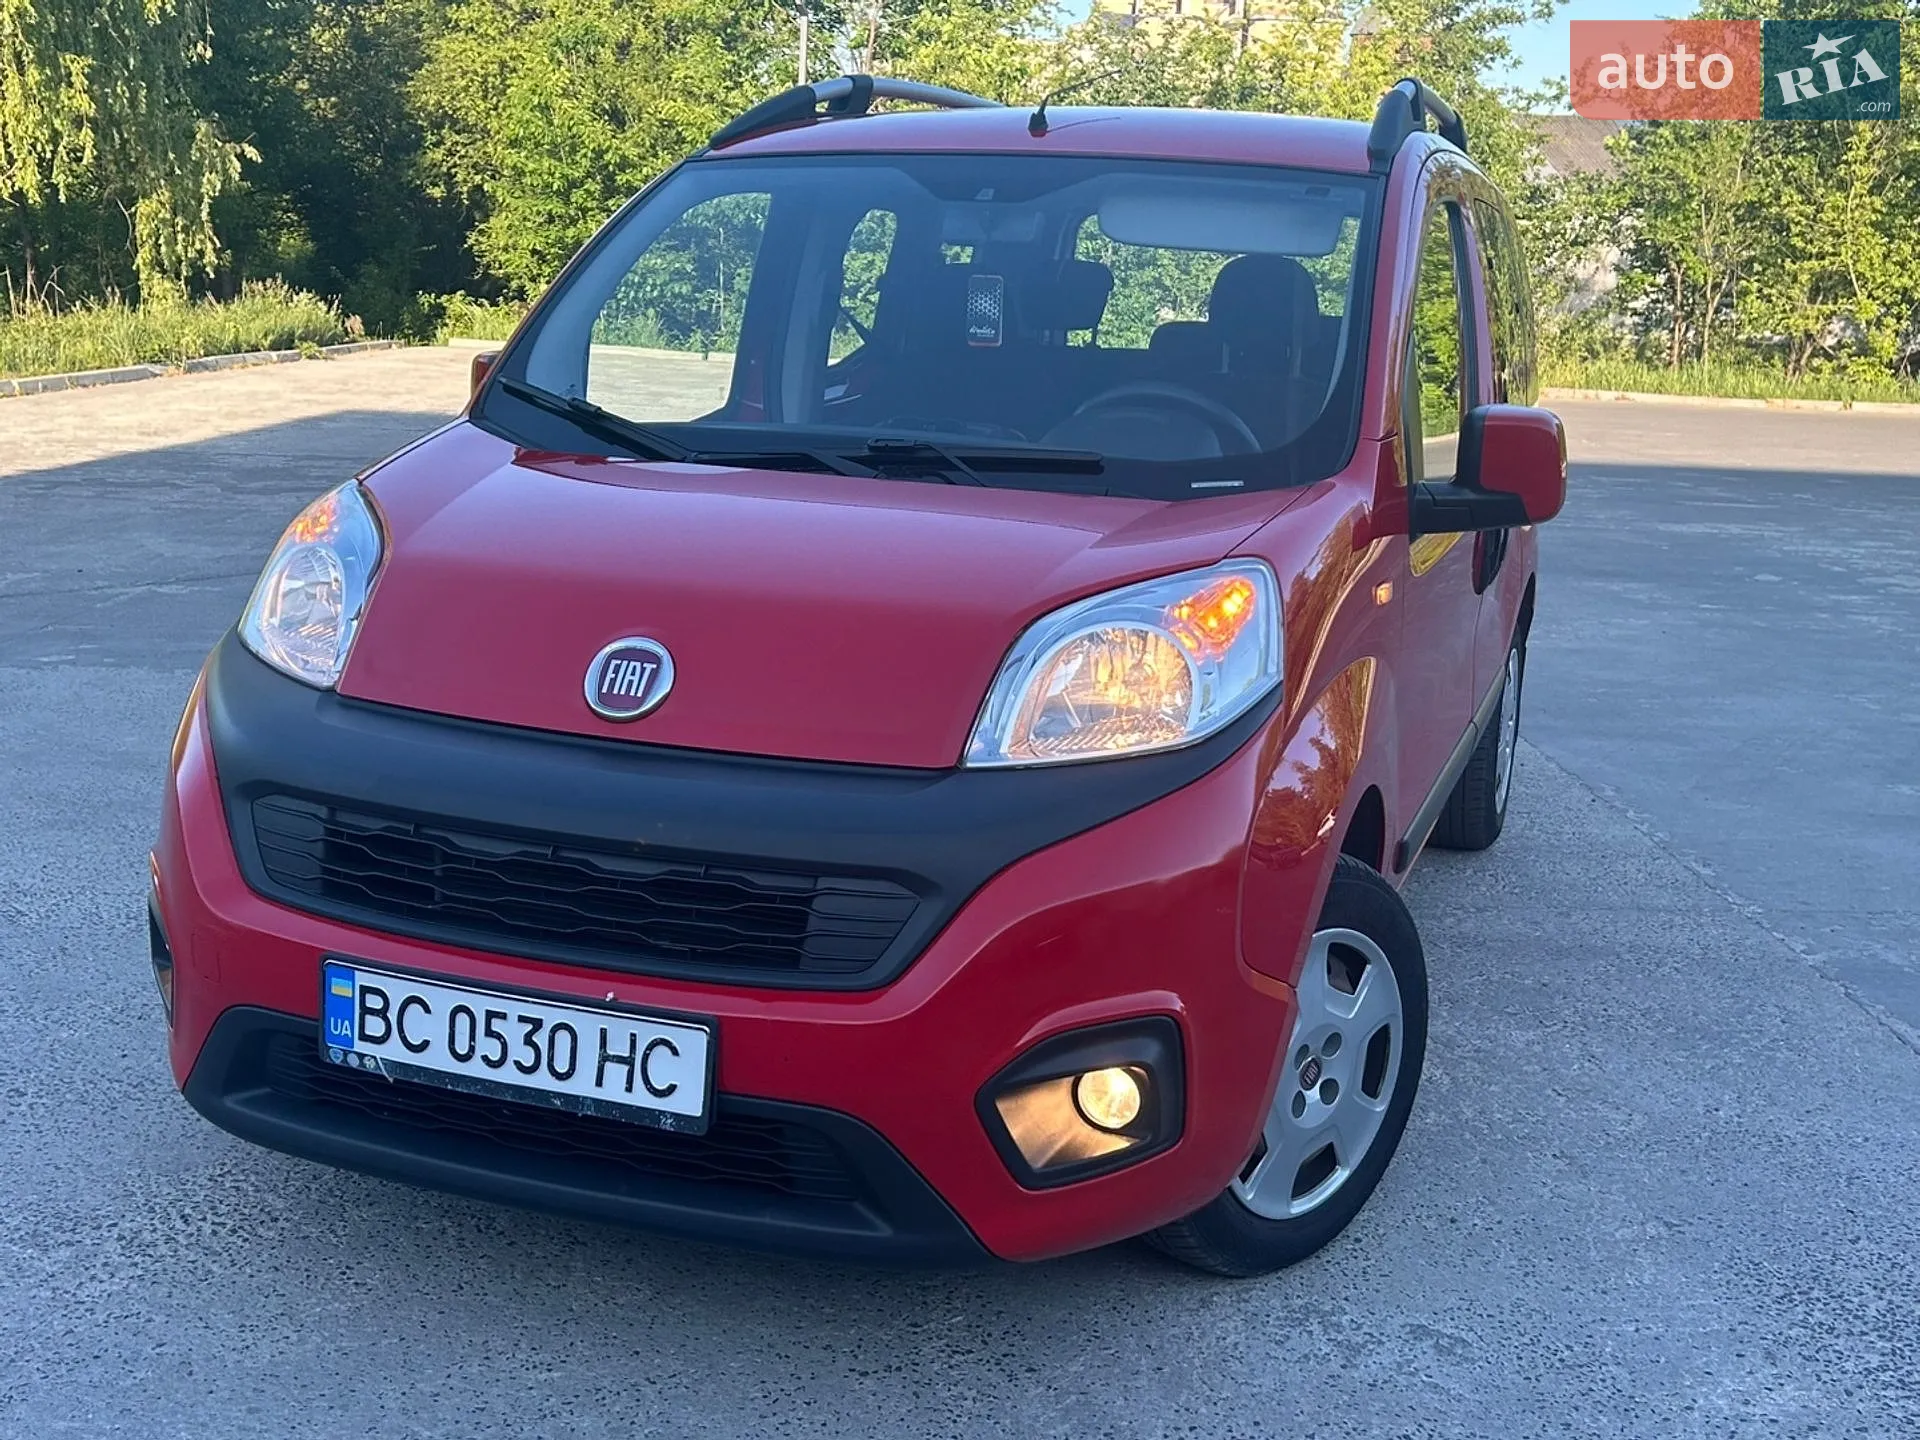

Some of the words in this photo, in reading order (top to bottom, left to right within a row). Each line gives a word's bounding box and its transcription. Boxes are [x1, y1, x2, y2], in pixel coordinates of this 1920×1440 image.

[601, 658, 658, 698] FIAT
[330, 1017, 352, 1039] UA
[358, 983, 433, 1054] BC
[447, 1003, 579, 1082] 0530
[594, 1026, 681, 1098] HC
